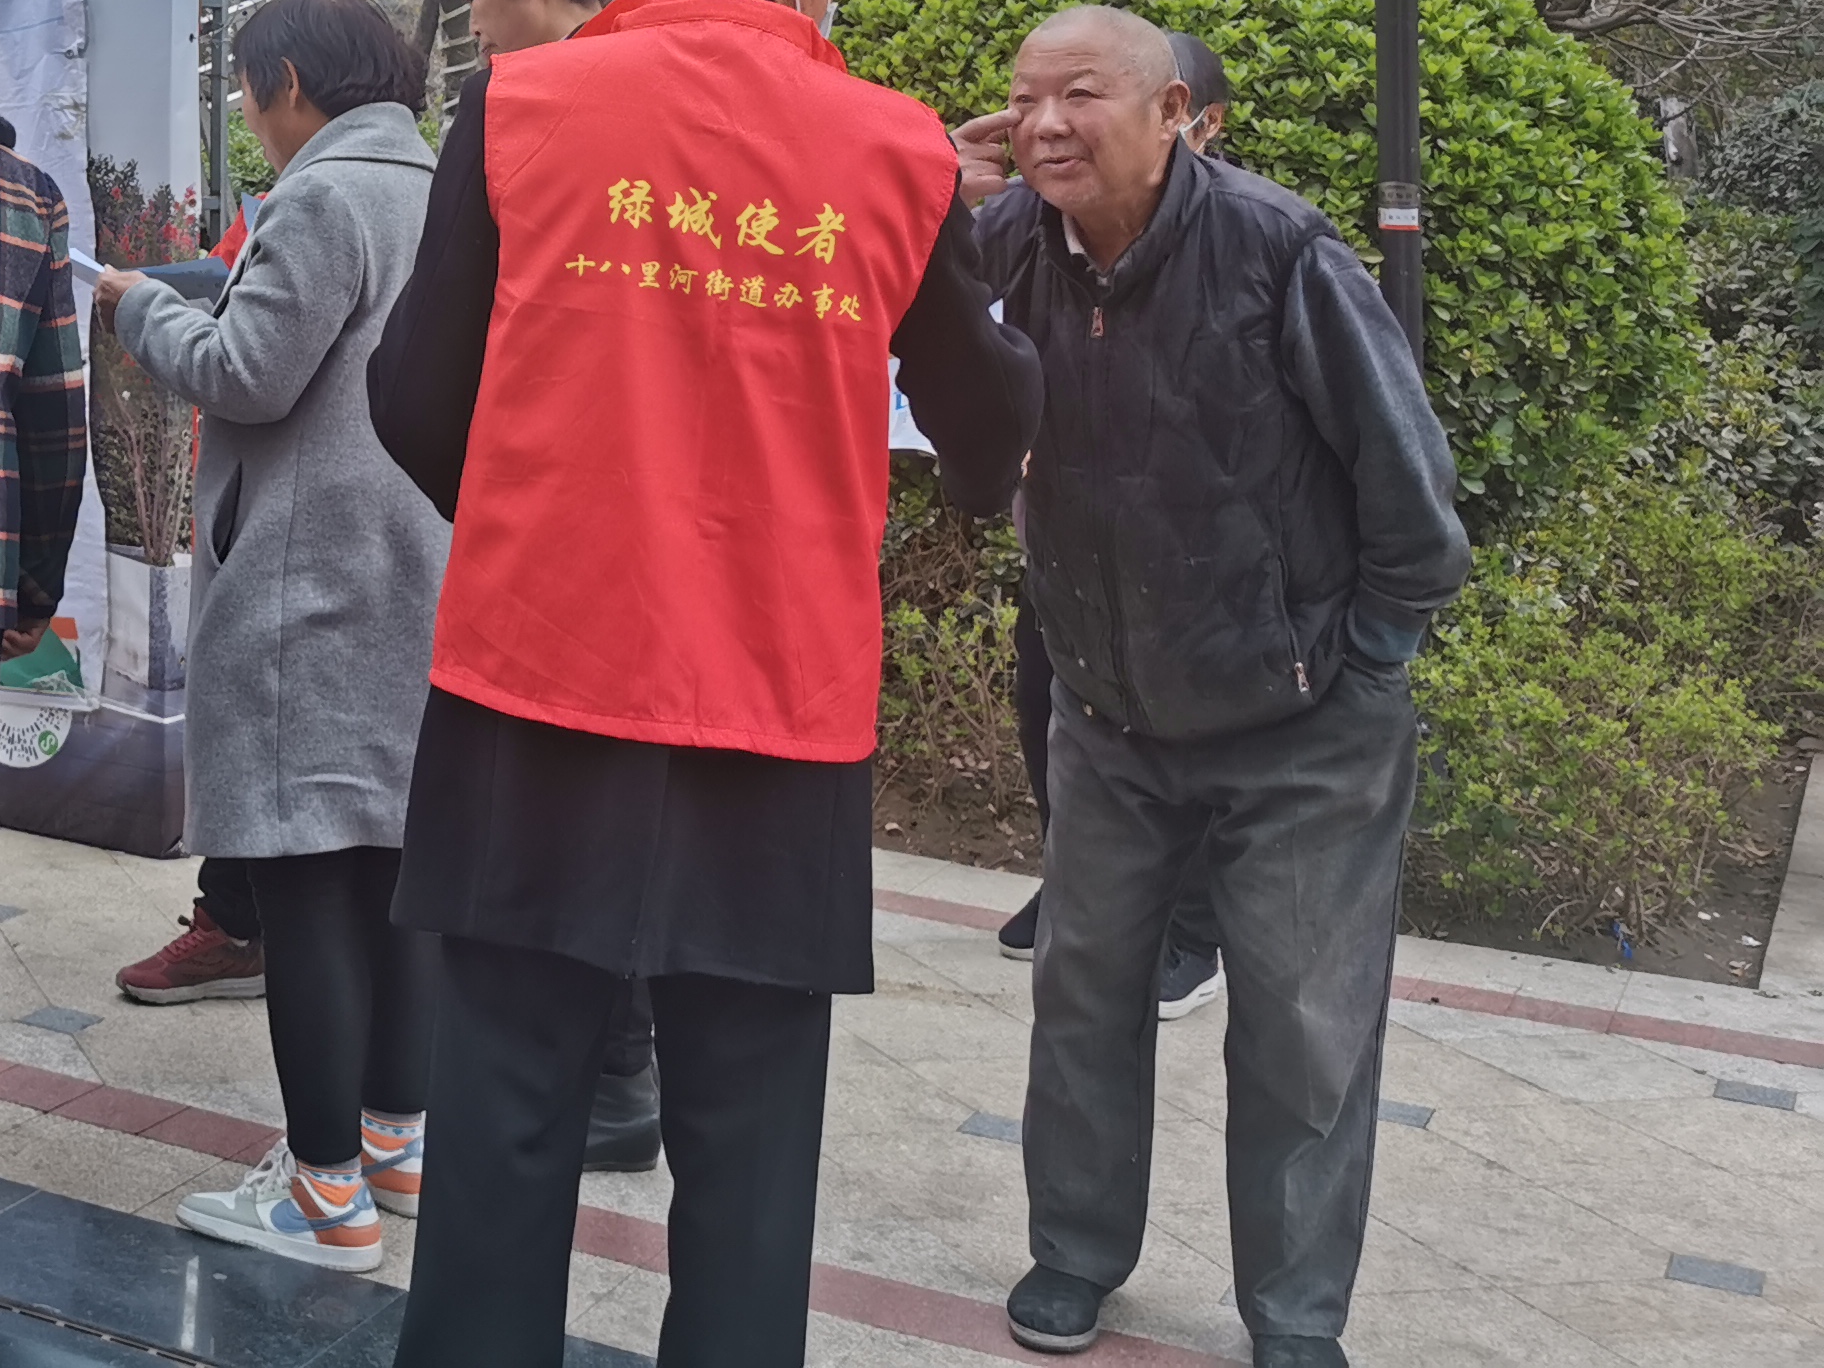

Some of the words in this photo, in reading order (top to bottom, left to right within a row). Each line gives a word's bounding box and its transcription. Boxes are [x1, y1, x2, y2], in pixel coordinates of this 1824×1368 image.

[608, 178, 846, 264] 绿城使者
[565, 254, 862, 321] 十八里河街道办事处
